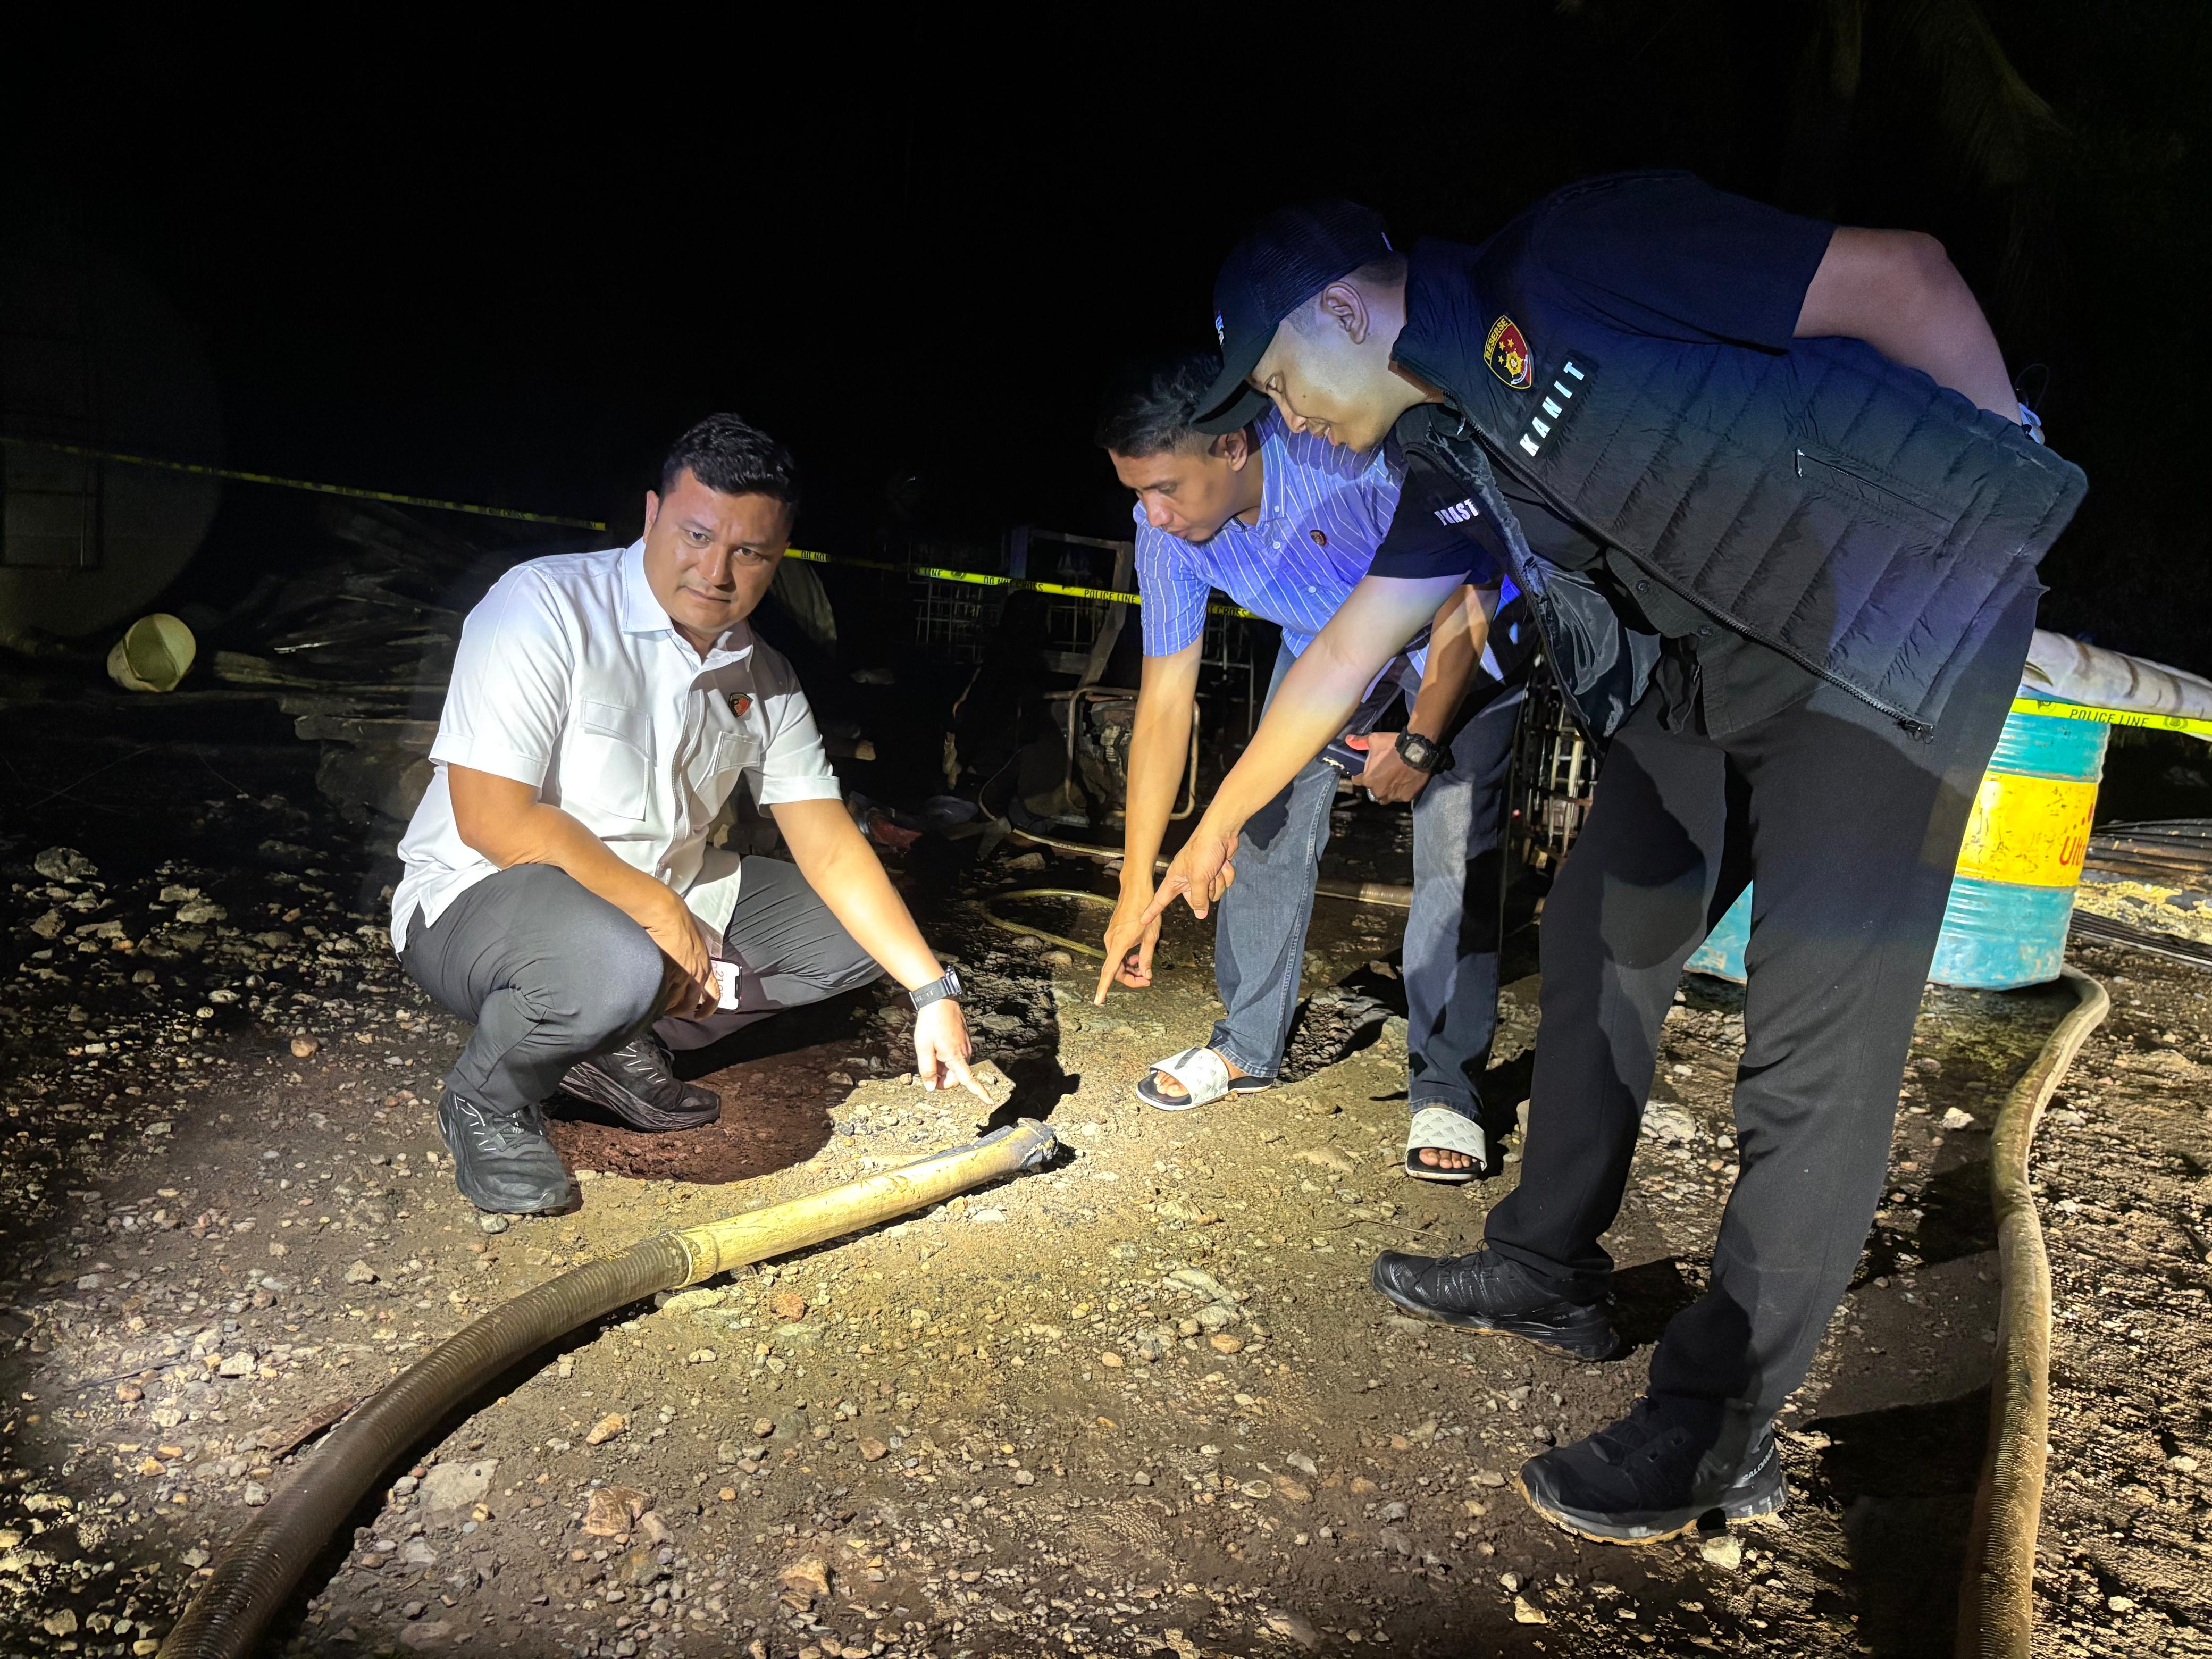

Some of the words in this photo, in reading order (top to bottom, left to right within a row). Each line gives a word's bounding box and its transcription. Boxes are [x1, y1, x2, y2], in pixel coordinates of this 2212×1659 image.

[1485, 318, 1508, 361] RESERSE
[1519, 361, 1585, 457] KANIT
[1084, 589, 1114, 601] POLICE
[1117, 593, 1136, 604] LINE
[1217, 606, 1247, 617] CROSS
[2069, 709, 2116, 723] POLICE
[2119, 716, 2149, 727] LINE
